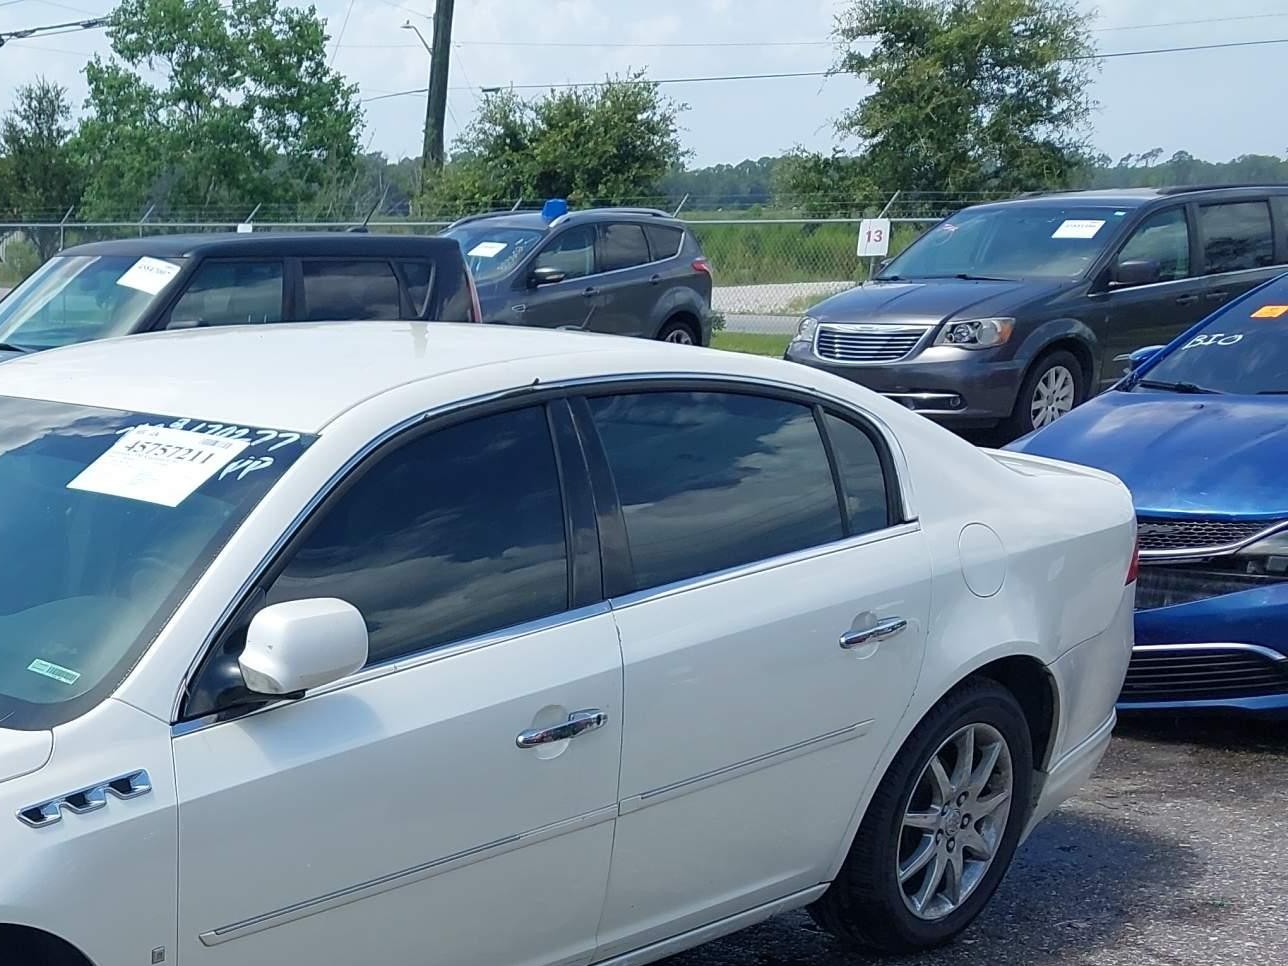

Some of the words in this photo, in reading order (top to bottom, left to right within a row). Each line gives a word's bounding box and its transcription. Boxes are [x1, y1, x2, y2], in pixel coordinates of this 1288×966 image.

[865, 229, 884, 243] 13
[1181, 333, 1245, 351] BIO
[124, 440, 215, 464] 45757211
